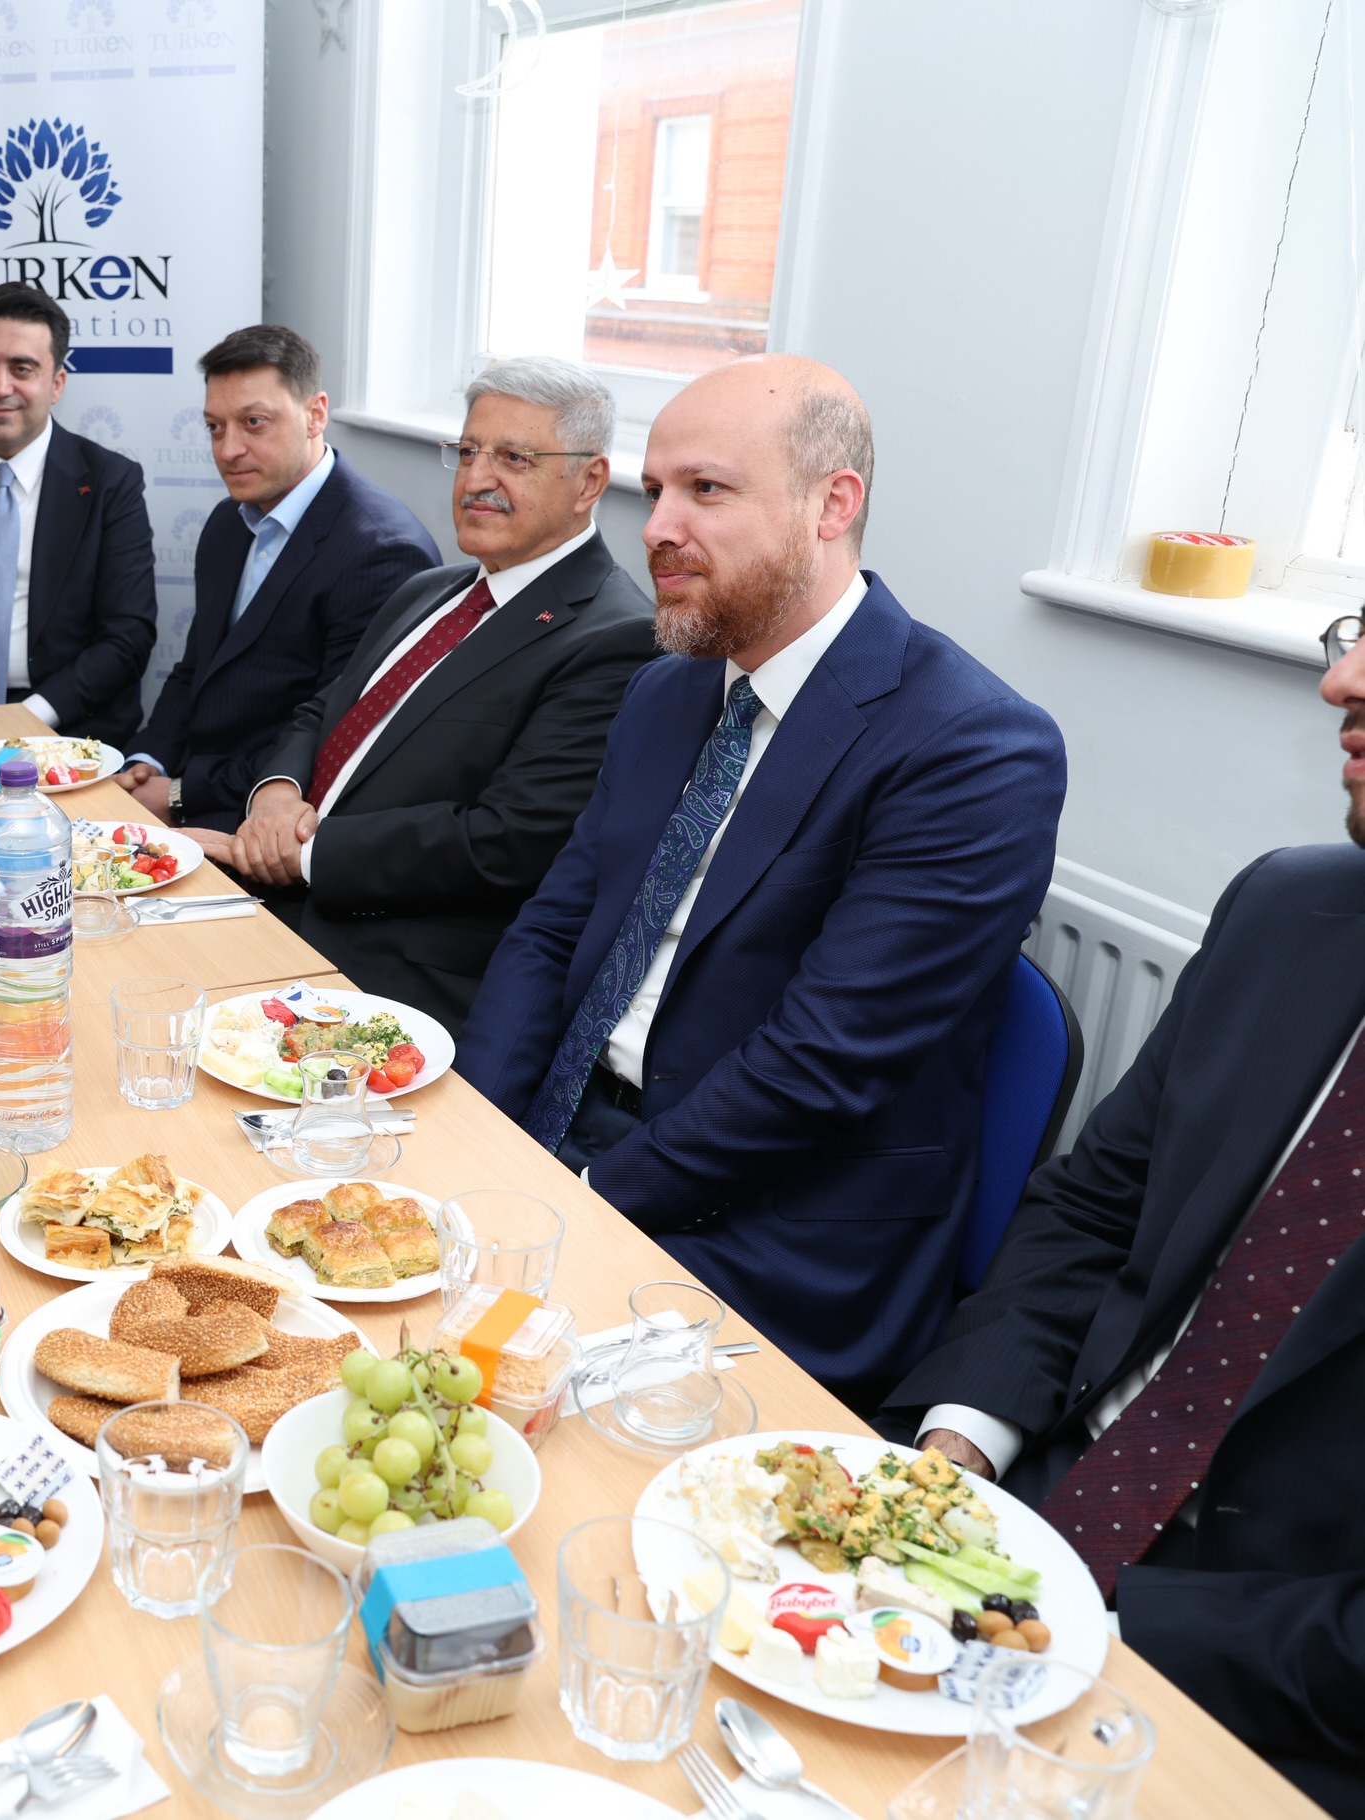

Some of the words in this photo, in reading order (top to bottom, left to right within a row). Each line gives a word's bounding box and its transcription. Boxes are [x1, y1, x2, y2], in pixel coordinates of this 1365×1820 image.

[20, 878, 73, 919] HIGHLA
[44, 899, 71, 922] SPRIN
[769, 1595, 837, 1611] Babybel
